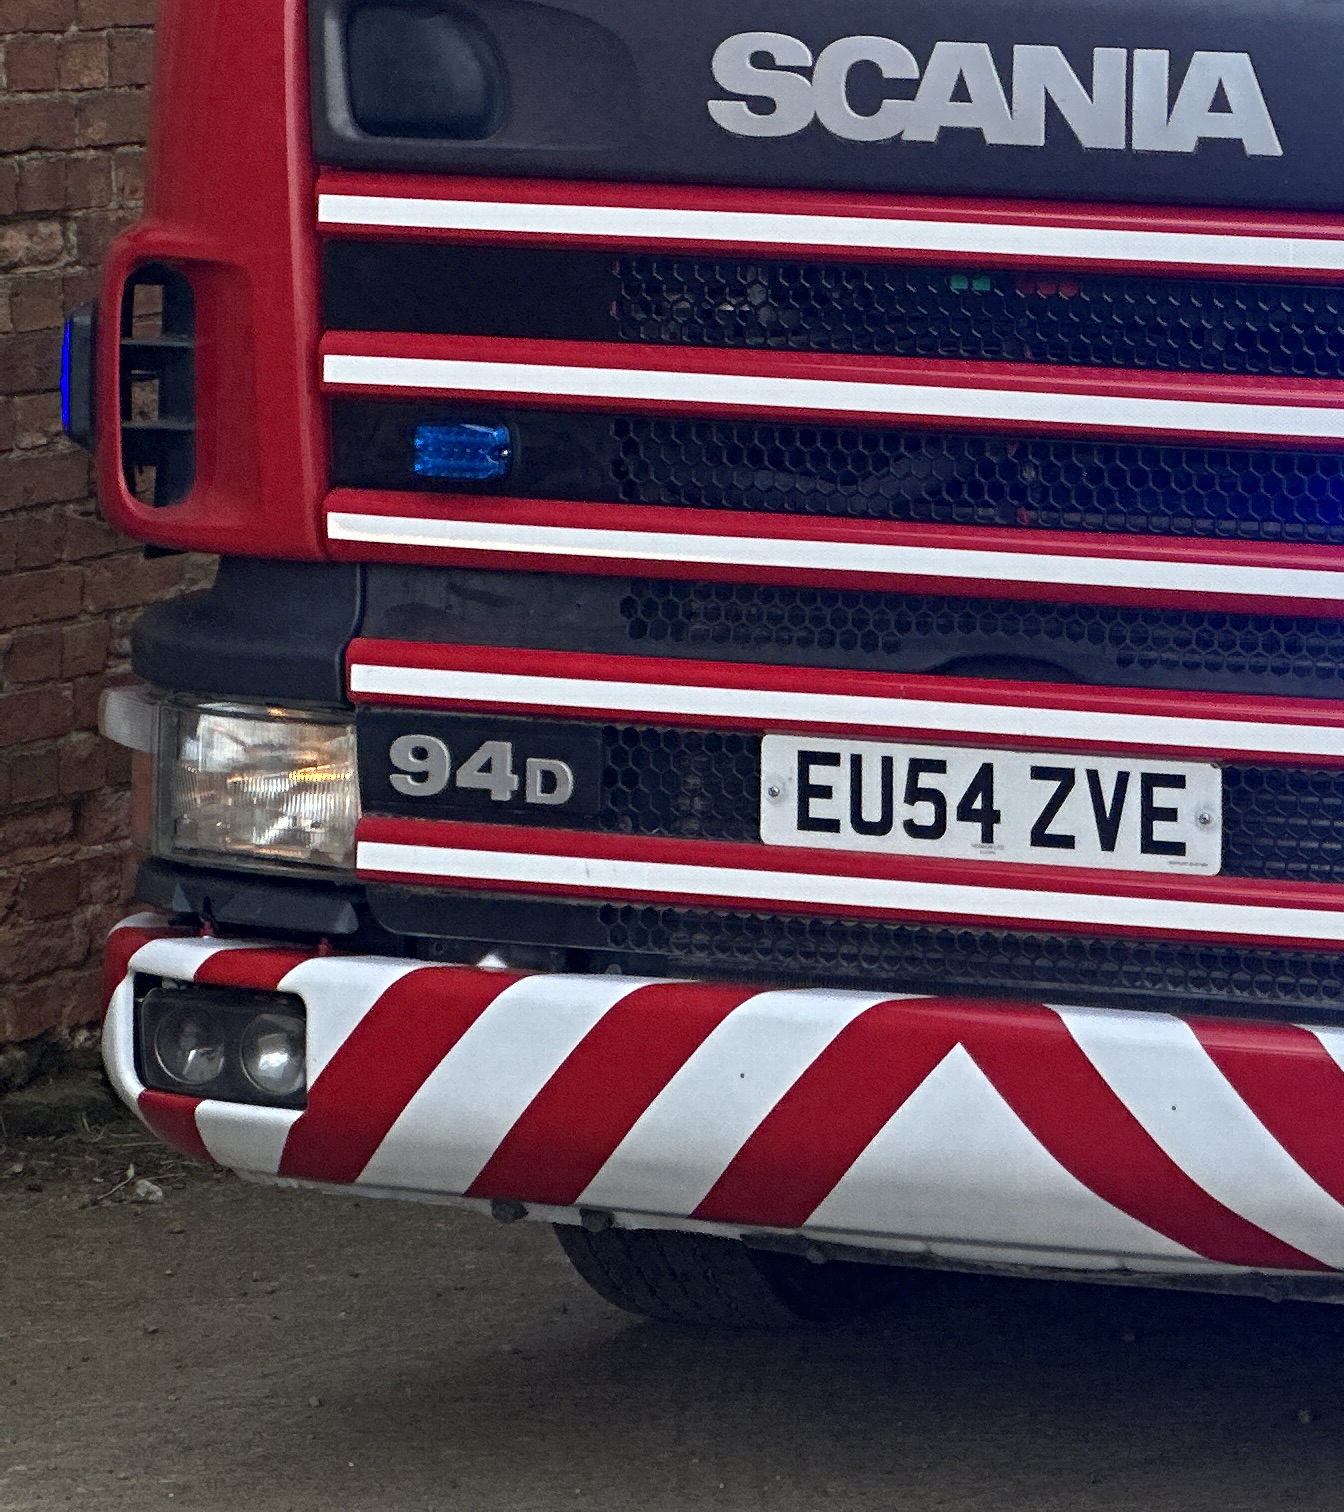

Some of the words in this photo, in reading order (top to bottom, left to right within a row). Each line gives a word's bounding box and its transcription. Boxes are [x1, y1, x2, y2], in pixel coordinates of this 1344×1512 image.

[707, 30, 1284, 158] SCANIA
[388, 733, 575, 806] 94D
[796, 748, 1002, 845] EU54
[1029, 764, 1188, 858] ZVE
